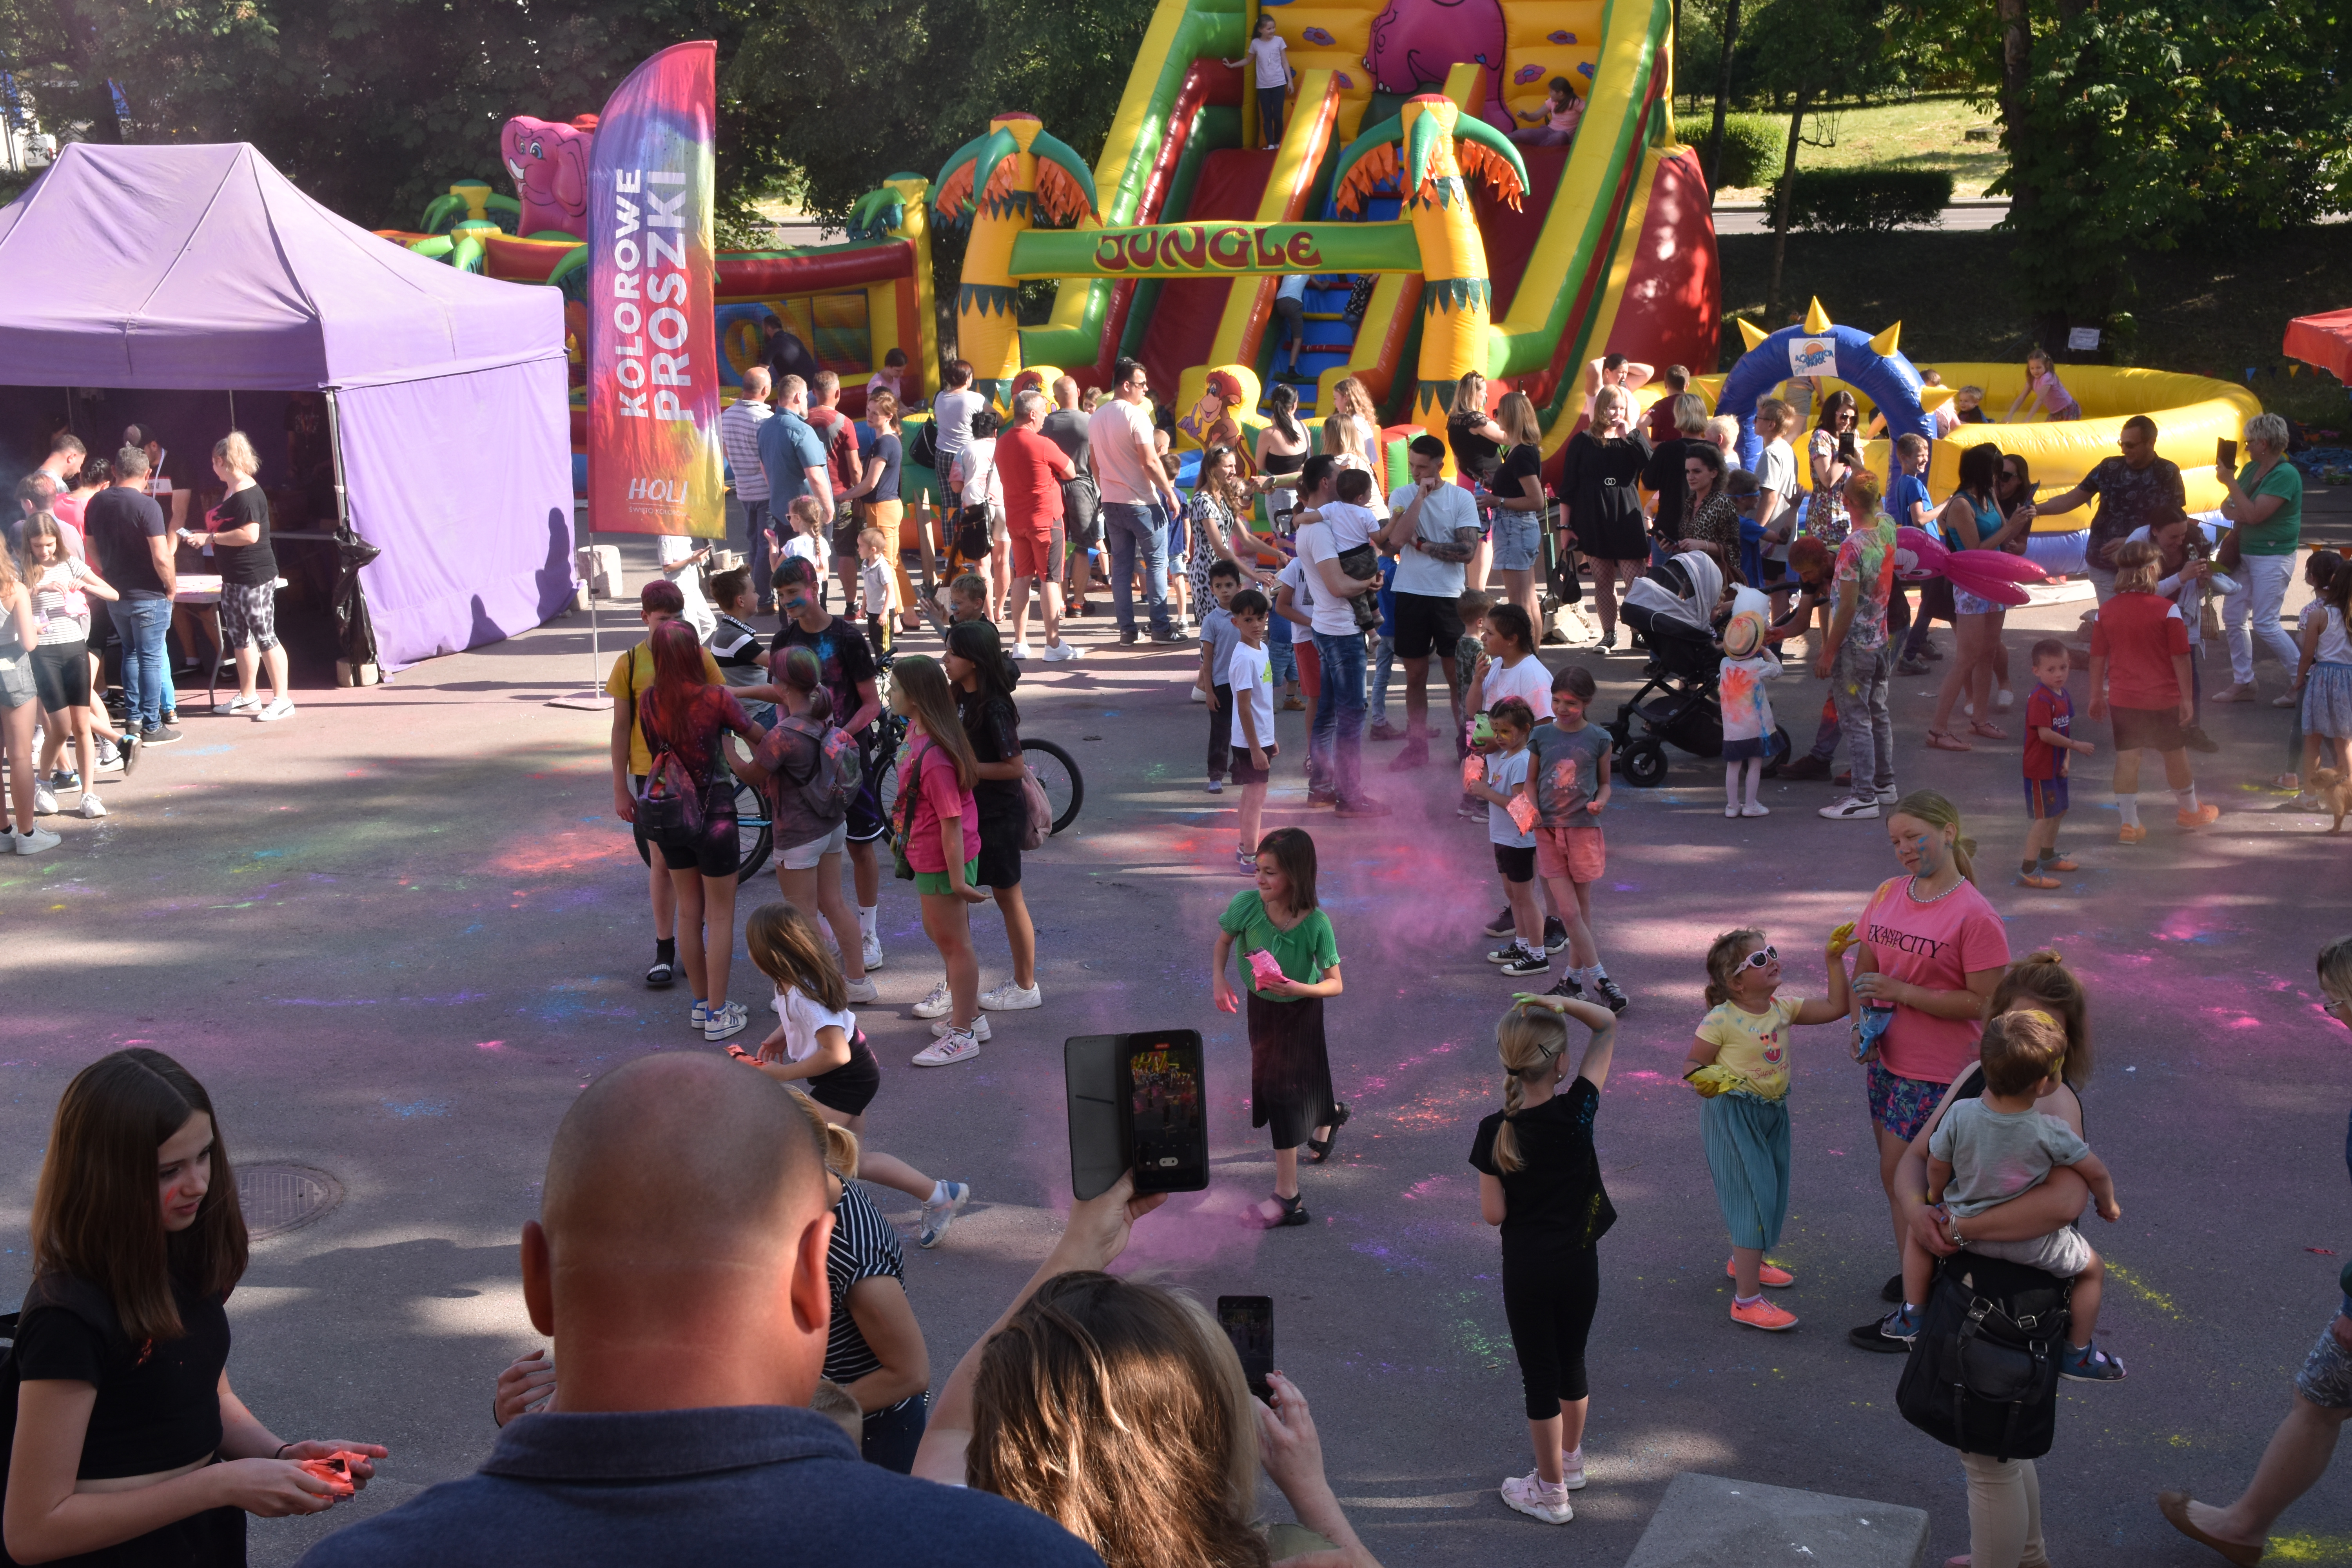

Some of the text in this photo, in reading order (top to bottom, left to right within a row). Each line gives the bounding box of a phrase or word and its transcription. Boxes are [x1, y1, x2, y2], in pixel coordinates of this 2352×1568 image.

[1094, 226, 1322, 272] JUNGLE
[614, 169, 649, 418] KOLOROWE
[647, 171, 695, 421] PROSZKI
[628, 478, 688, 505] HOLI
[629, 506, 687, 517] ŚWIĘTO KOLORÓW
[1868, 924, 1949, 959] EX AND THE CITY
[1744, 1067, 1777, 1080] Super
